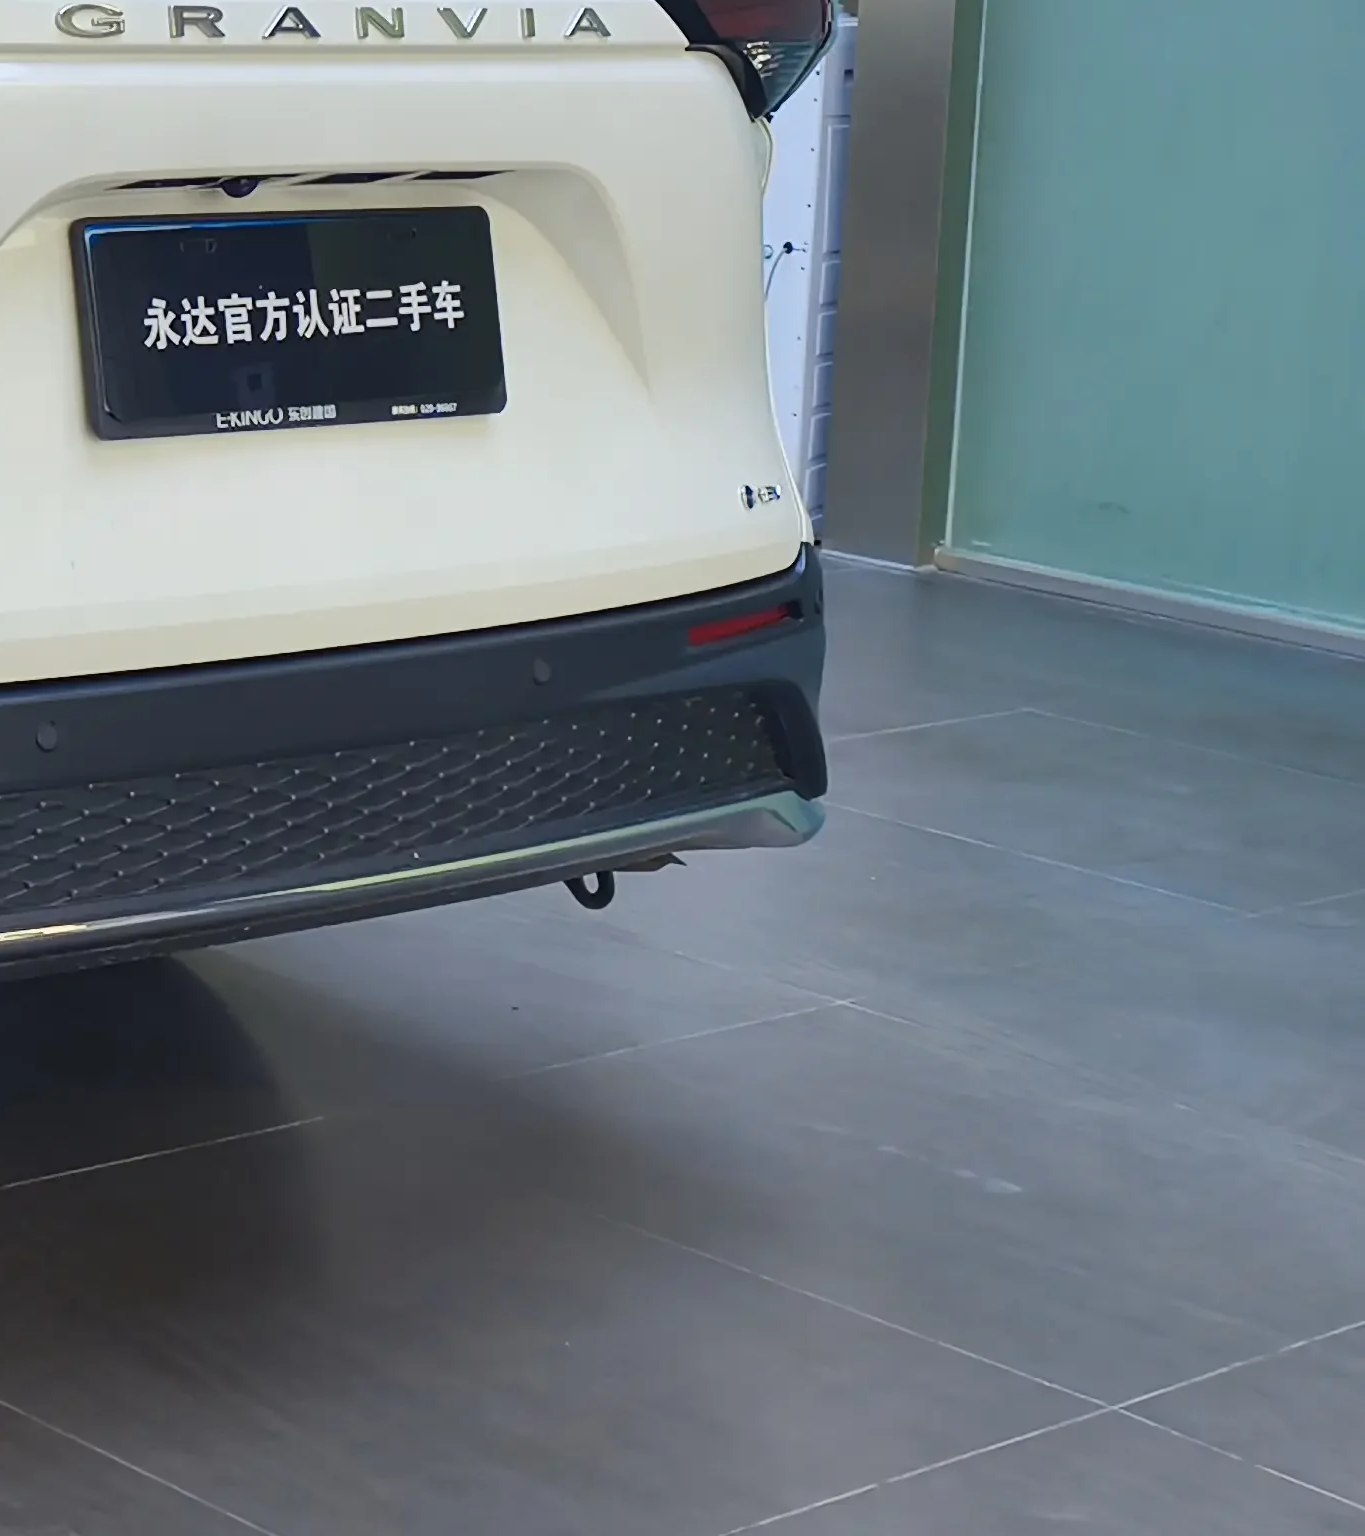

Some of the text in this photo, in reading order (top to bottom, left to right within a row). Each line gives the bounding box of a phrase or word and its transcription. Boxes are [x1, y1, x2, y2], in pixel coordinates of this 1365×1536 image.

[54, 3, 612, 39] GRANVIA
[144, 280, 465, 350] 永达官方认证二手车
